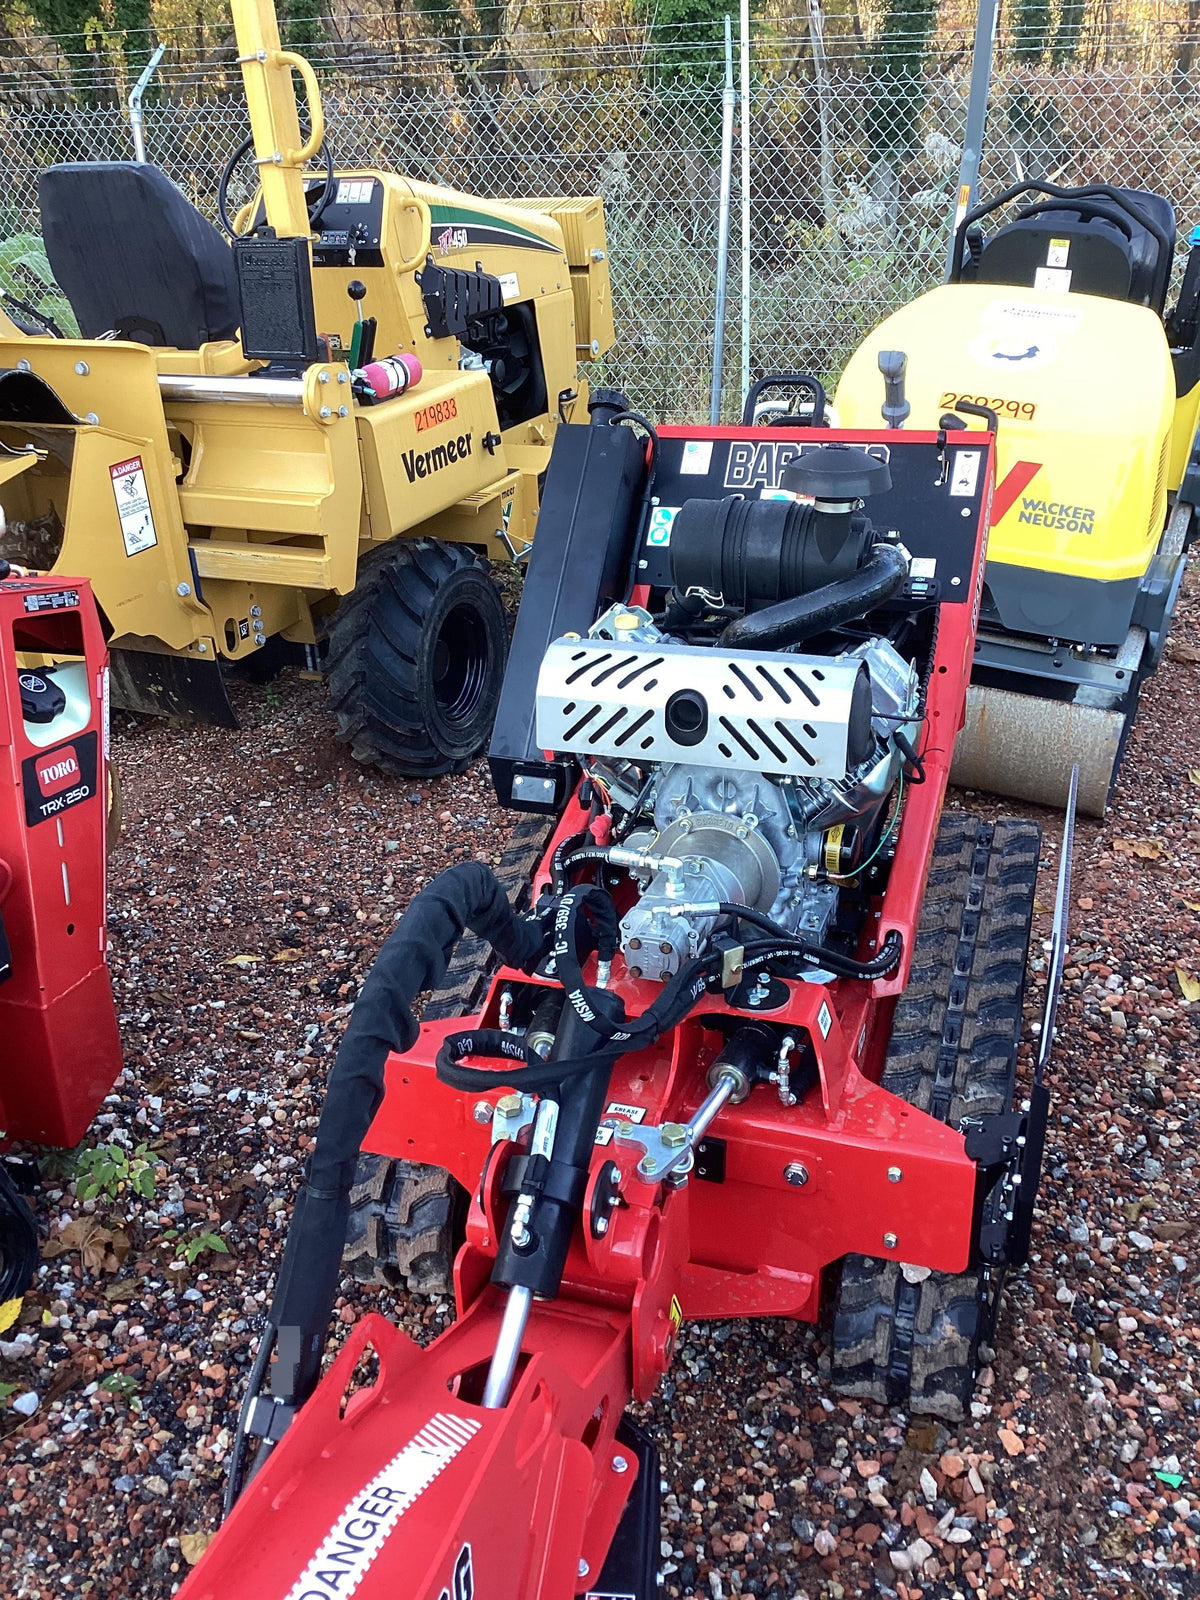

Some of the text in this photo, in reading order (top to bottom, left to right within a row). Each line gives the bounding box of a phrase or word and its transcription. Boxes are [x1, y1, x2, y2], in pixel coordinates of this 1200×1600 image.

[453, 229, 467, 248] 450
[414, 398, 458, 432] 219833
[117, 460, 141, 475] DANGER
[401, 432, 472, 484] Vermeer
[1018, 510, 1095, 535] NEUSON
[1021, 497, 1095, 522] WACKER
[39, 758, 76, 785] TORO
[568, 988, 596, 1022] MSHA
